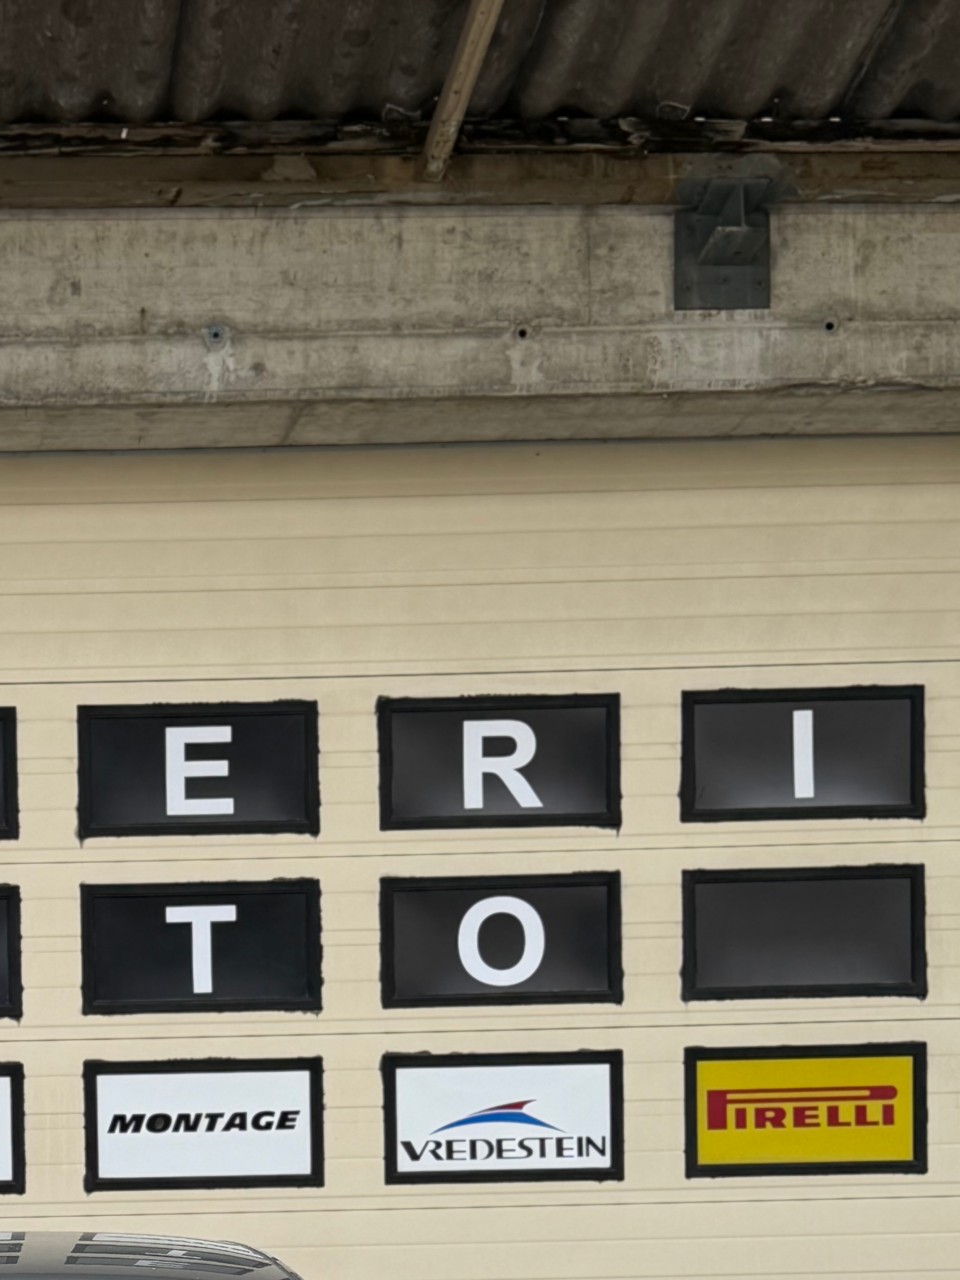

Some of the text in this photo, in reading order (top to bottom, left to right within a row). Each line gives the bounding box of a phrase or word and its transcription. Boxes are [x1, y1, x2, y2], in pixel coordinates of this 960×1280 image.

[105, 1110, 301, 1135] MONTAGE
[706, 1085, 898, 1132] PIRELLI
[400, 1135, 608, 1164] VREDESTEIN
